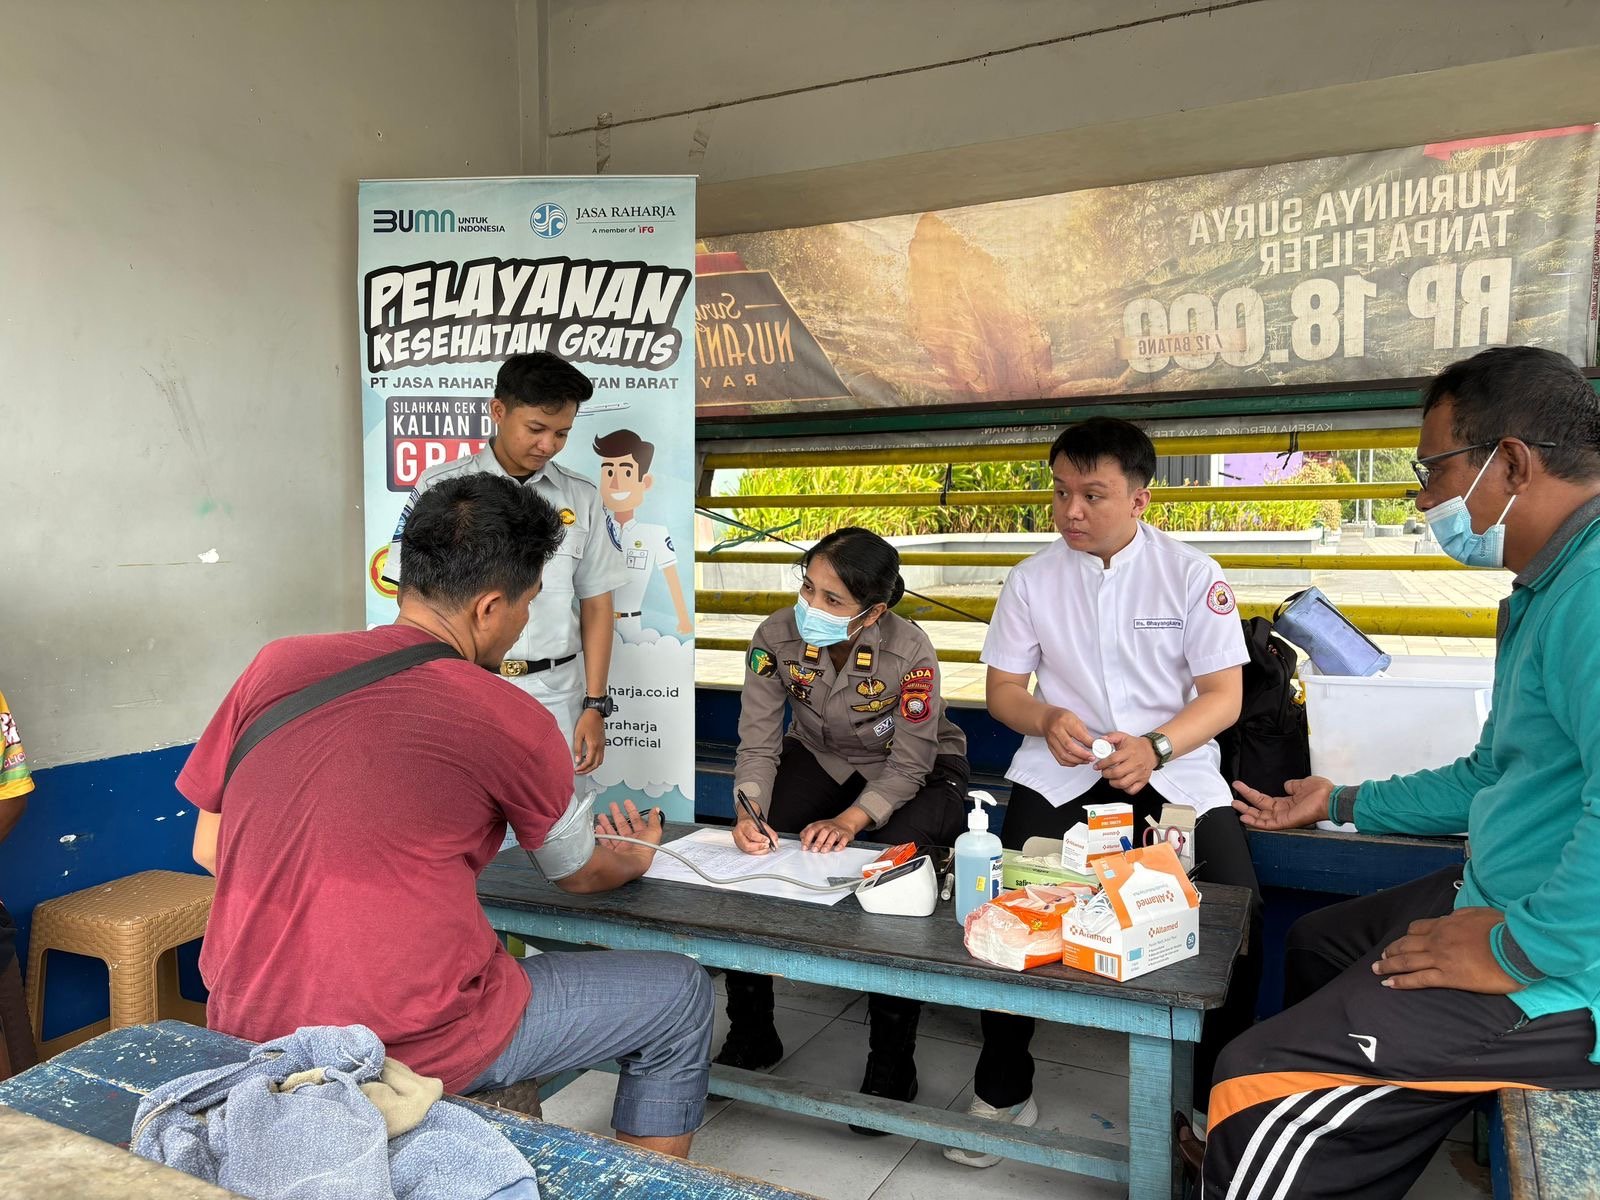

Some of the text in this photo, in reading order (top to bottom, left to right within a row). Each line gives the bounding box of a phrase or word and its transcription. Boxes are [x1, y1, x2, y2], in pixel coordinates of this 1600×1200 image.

[576, 206, 676, 220] JASA RAHARJA
[458, 216, 488, 225] UNTUK
[458, 224, 506, 233] INDONESIA
[368, 261, 687, 330] PELAYANAN
[373, 323, 676, 368] KESEHATAN GRATIS
[370, 377, 388, 389] PT
[393, 377, 435, 389] JASA
[438, 377, 498, 389] RAHAR
[627, 377, 679, 389] BARAT
[393, 401, 449, 414] SILAHKAN
[454, 402, 476, 414] CEK
[393, 415, 470, 436] KALIAN
[608, 685, 679, 698] harja.co.id
[604, 720, 657, 733] araharja
[605, 736, 661, 748] aOfficial
[1136, 894, 1166, 910] Altamed
[1155, 921, 1179, 935] Altamed
